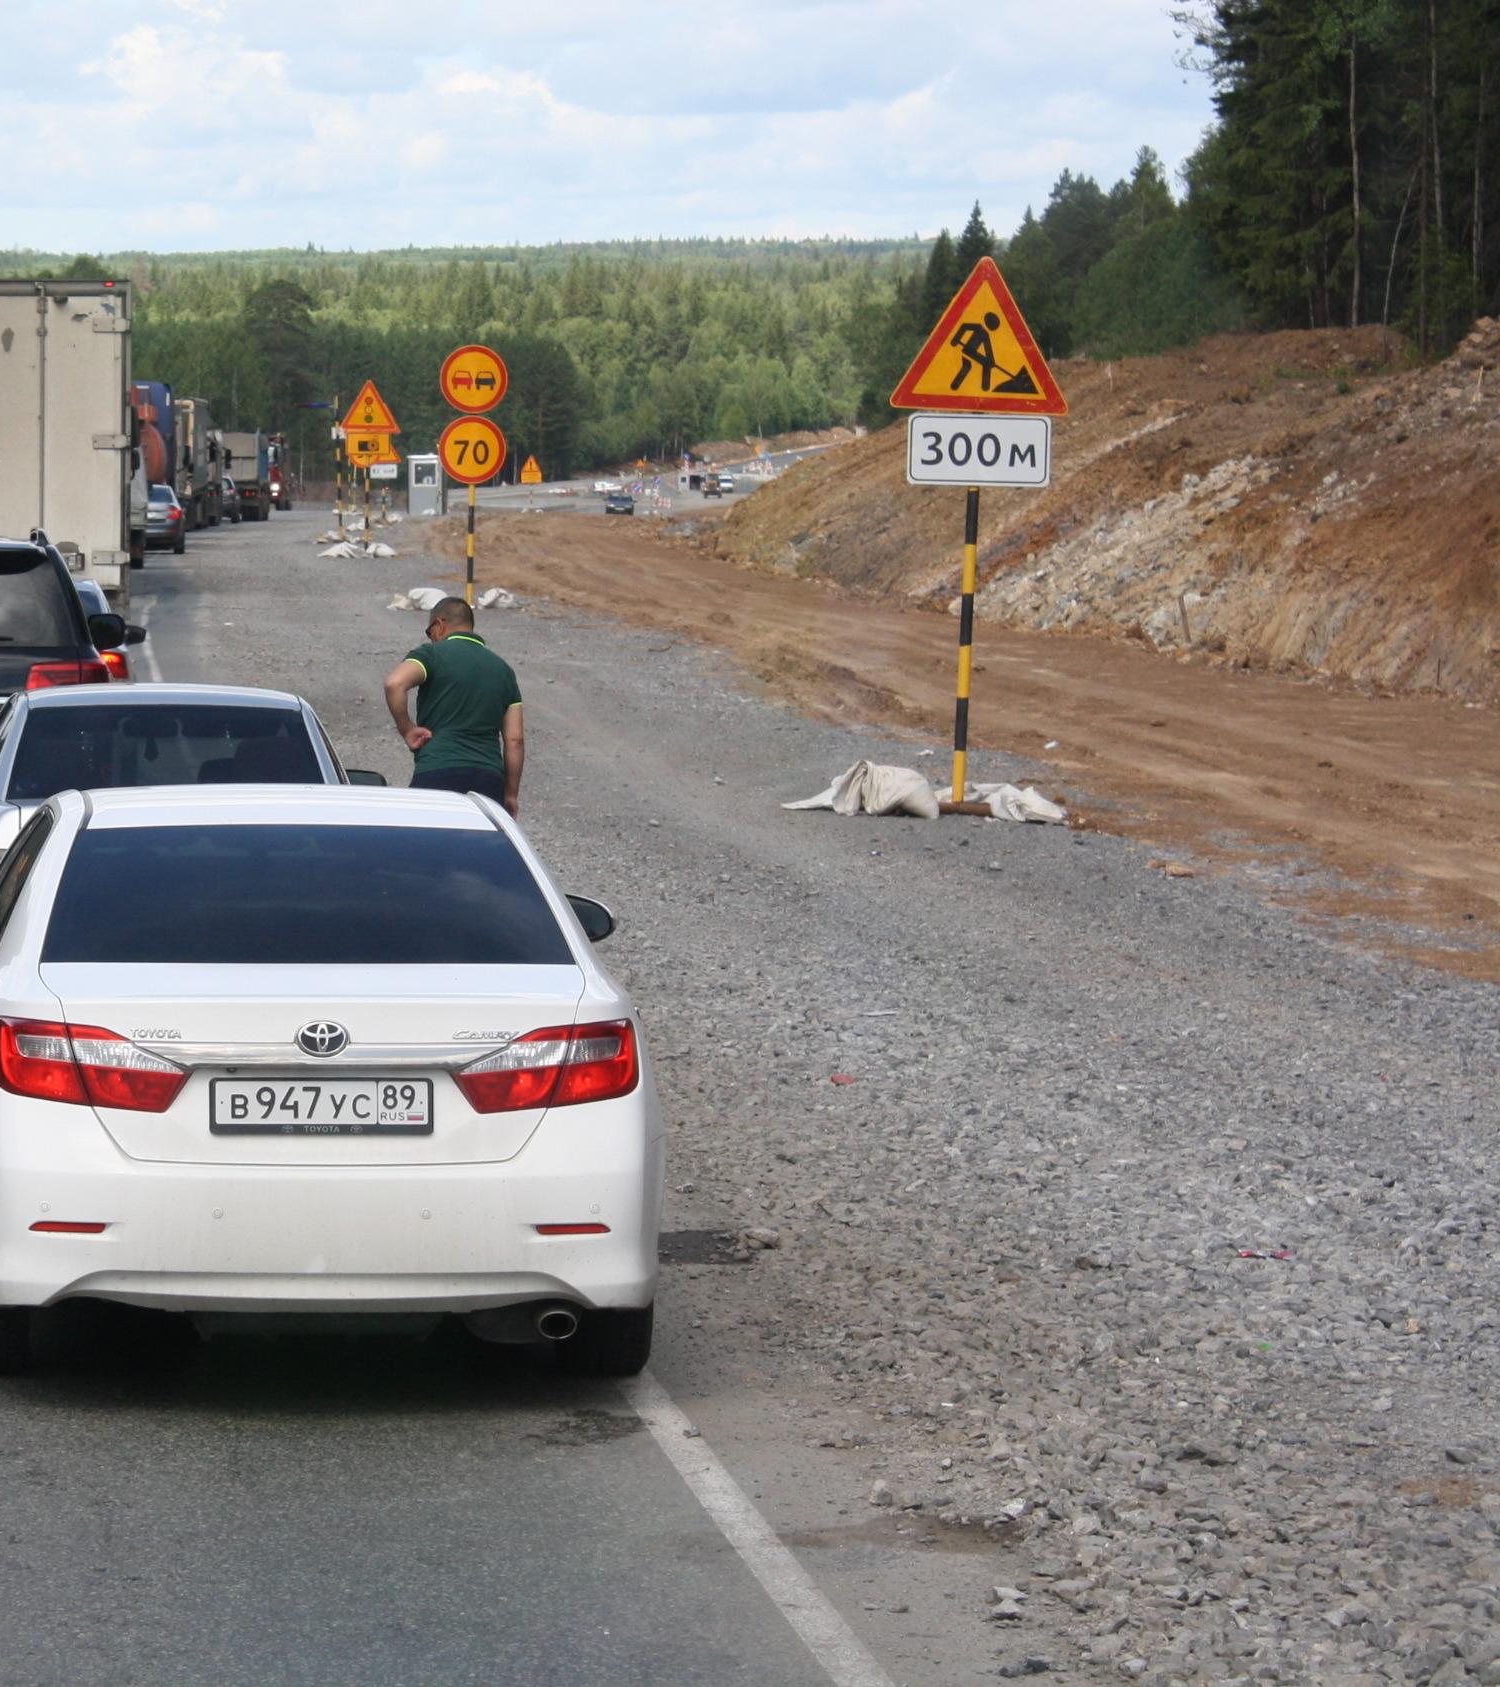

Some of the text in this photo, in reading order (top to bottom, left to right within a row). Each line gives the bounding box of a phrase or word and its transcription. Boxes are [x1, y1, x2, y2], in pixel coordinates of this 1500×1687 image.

[453, 440, 489, 465] 70
[130, 1028, 182, 1039] TOYOTA
[382, 1085, 416, 1110] 89
[380, 1112, 405, 1121] RUS
[304, 1125, 340, 1133] TOYOTA
